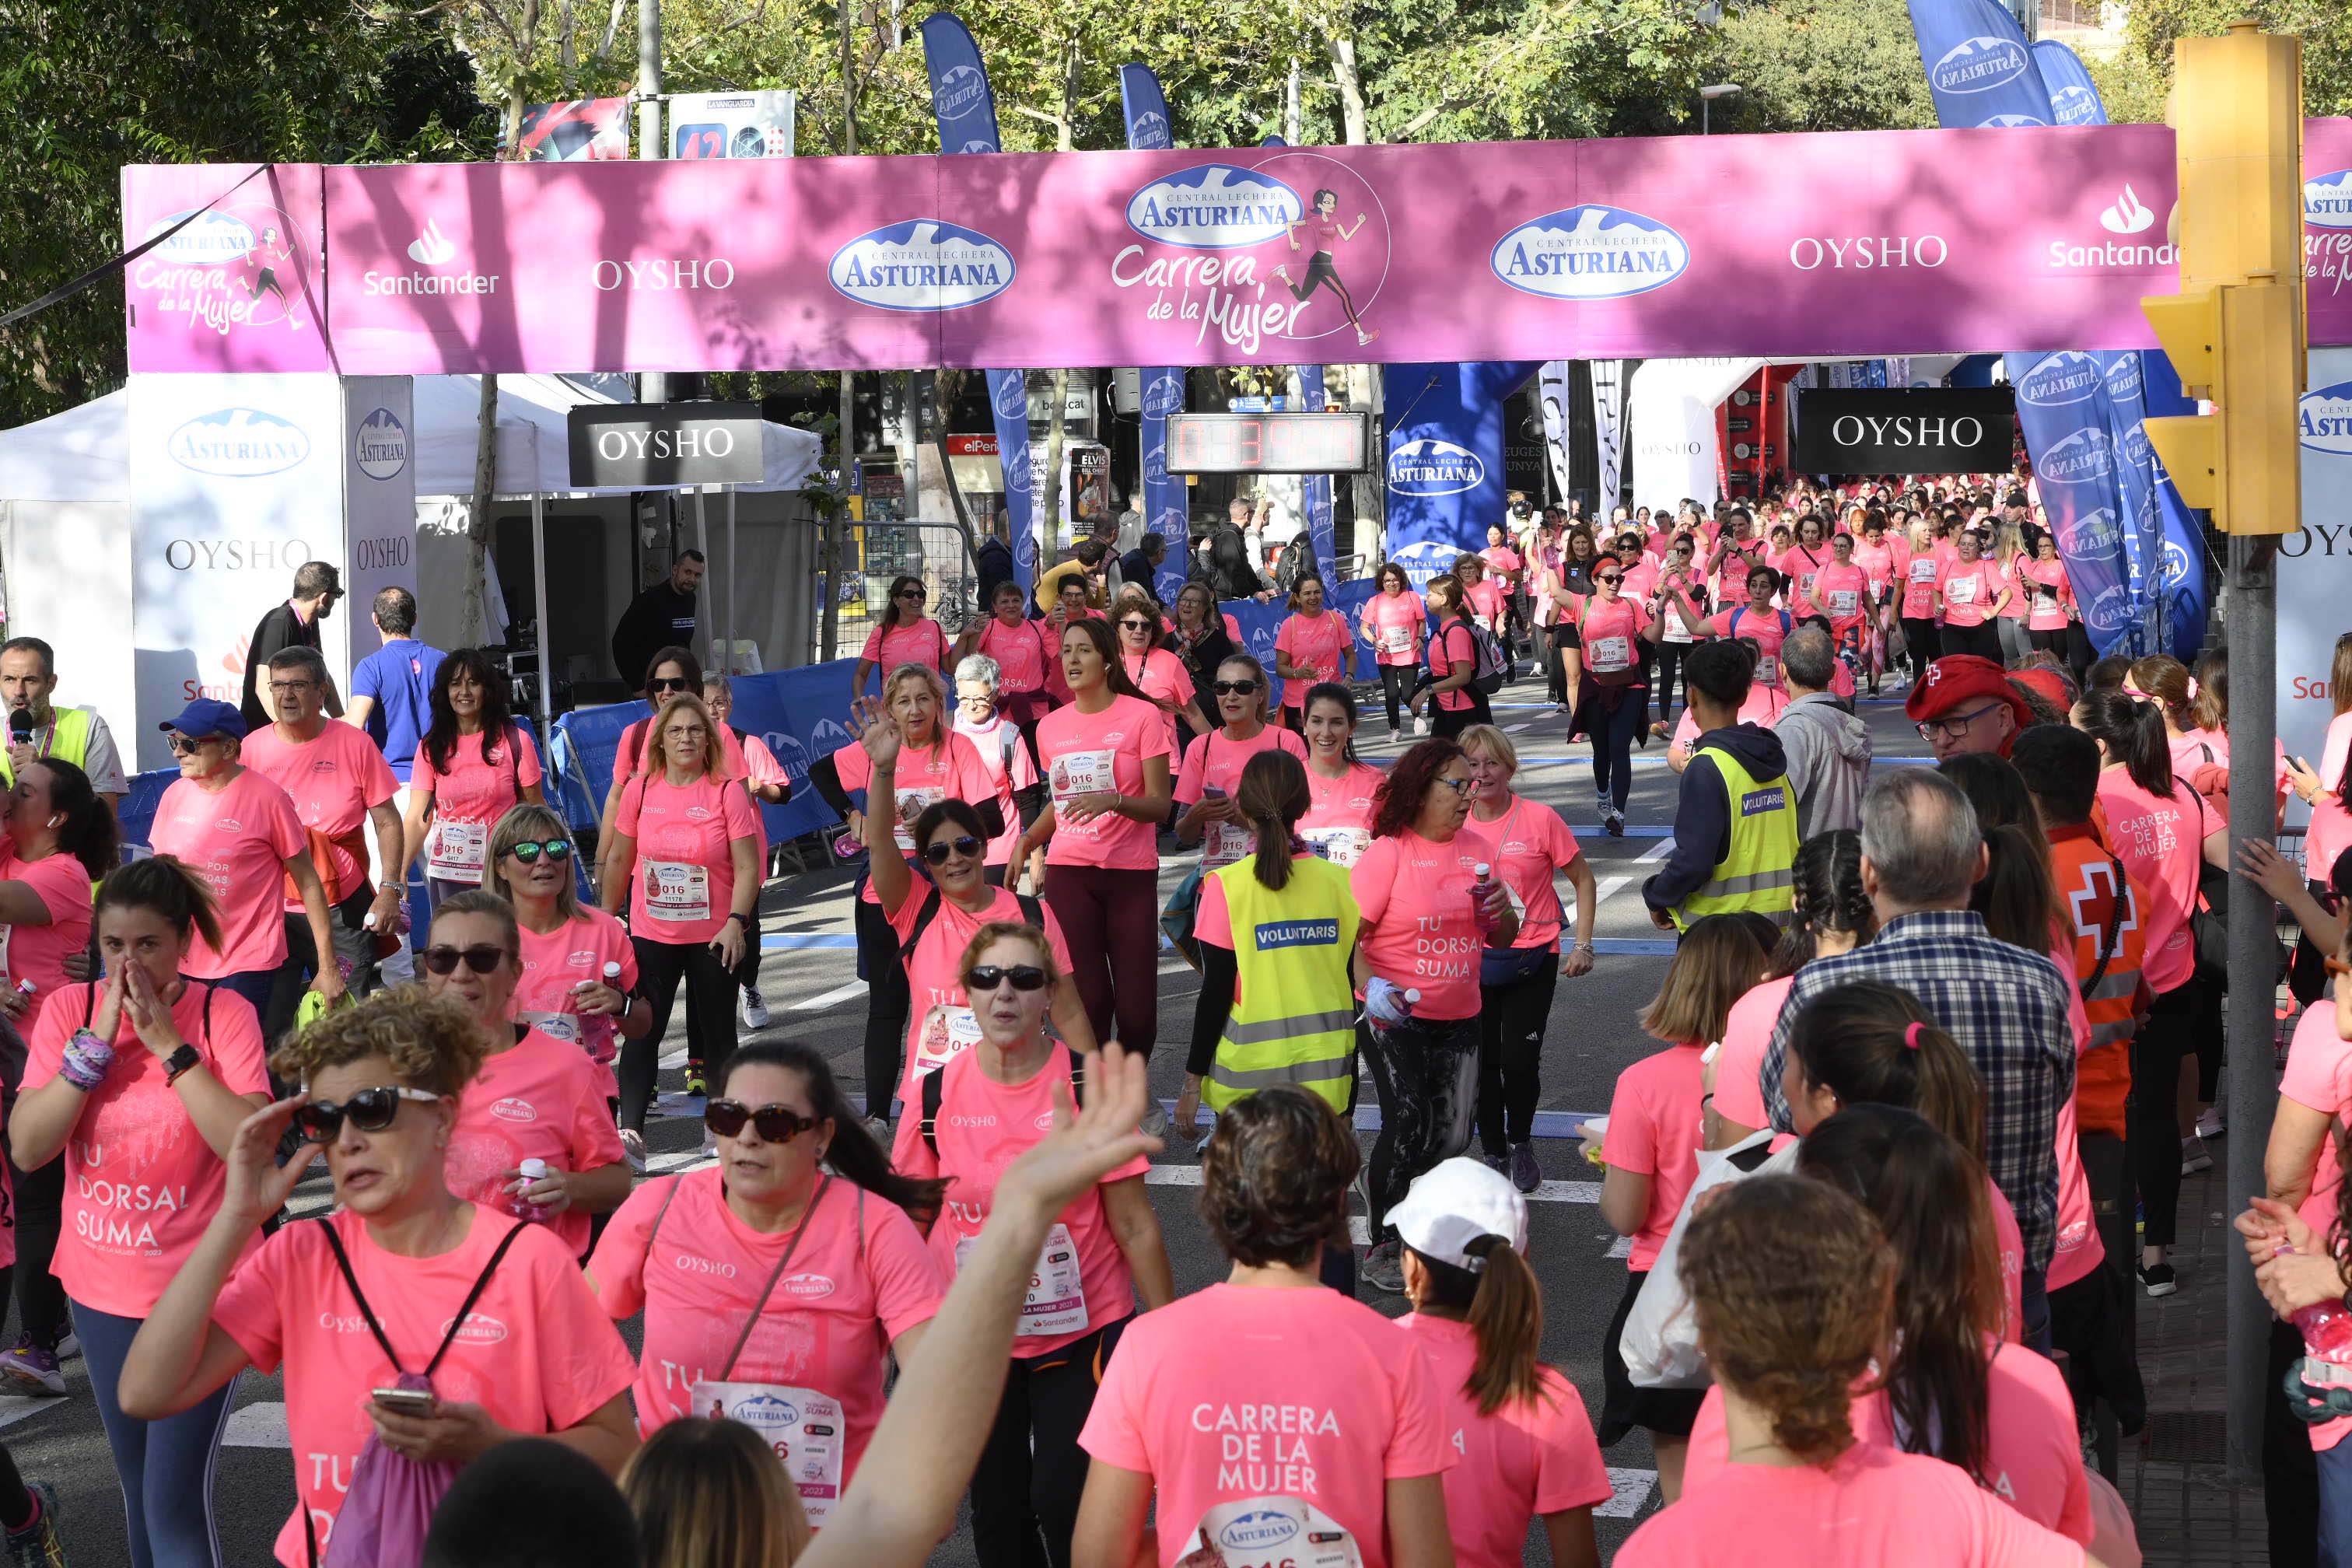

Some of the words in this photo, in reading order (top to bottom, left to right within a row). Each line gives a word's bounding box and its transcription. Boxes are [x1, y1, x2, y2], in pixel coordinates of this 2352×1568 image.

[1167, 193, 1222, 202] CENTRAL
[1228, 191, 1284, 201] LECHERA
[1139, 195, 1290, 228] ASTURIANA
[1536, 236, 1598, 248] CENTRAL
[1604, 236, 1668, 247] LECHERA
[871, 250, 931, 261] CENTRAL
[936, 249, 995, 261] LECHERA
[1506, 240, 1675, 276] ASTURIANA
[1790, 236, 1948, 270] OYSHO
[135, 261, 228, 292] Carrera
[592, 258, 735, 291] OYSHO
[843, 254, 1001, 288] ASTURIANA
[1111, 244, 1257, 288] Carrera
[2322, 257, 2336, 278] la
[364, 271, 499, 296] Santander
[158, 295, 176, 312] de
[177, 293, 191, 312] la
[188, 292, 262, 335] Mujer
[1146, 296, 1173, 320] de
[1180, 289, 1200, 320] la
[1195, 282, 1312, 355] Mujer
[2320, 406, 2352, 415] CENT
[1832, 415, 1984, 448] OYSHO
[179, 433, 301, 460] ASTURIANA
[360, 438, 404, 463] ASTURIANA
[597, 426, 734, 461] OYSHO
[964, 439, 999, 453] elPeri
[1082, 455, 1105, 464] ELVIS
[1435, 457, 1474, 466] LECHERA
[1388, 464, 1477, 484] ASTURIANA
[166, 538, 312, 571] OYSHO
[356, 535, 409, 571] OYSHO
[1071, 773, 1093, 784] 016
[2119, 809, 2181, 833] CARRERA
[2134, 828, 2152, 844] DE
[2155, 824, 2174, 838] LA
[444, 845, 464, 855] 016
[1222, 841, 1243, 850] 016
[2134, 837, 2179, 858] MUJER
[207, 862, 229, 872] POR
[198, 873, 229, 885] ODAS
[662, 885, 685, 894] 016
[212, 887, 228, 897] AS
[1417, 915, 1442, 932] TU
[1415, 959, 1471, 978] SUMA
[954, 1022, 983, 1033] ASTURIA
[950, 1115, 997, 1127] OYSHO
[79, 1174, 188, 1211] DORSAL
[948, 1201, 982, 1223] TU
[77, 1209, 159, 1248] SUMA
[1047, 1237, 1066, 1248] UMA
[675, 1255, 737, 1279] OYSHO
[1033, 1304, 1057, 1314] MUJER
[1041, 1315, 1080, 1327] Santander
[660, 1360, 703, 1393] TU
[740, 1408, 794, 1422] ASTURIANA
[804, 1406, 834, 1417] SUMA
[1192, 1403, 1341, 1437] CARRERA
[1223, 1434, 1262, 1462] DE
[1274, 1435, 1311, 1464] LA
[309, 1453, 359, 1493] TU
[1217, 1466, 1318, 1495] MUJER
[803, 1486, 824, 1495] 2023
[1227, 1524, 1294, 1544] ASTURIANA
